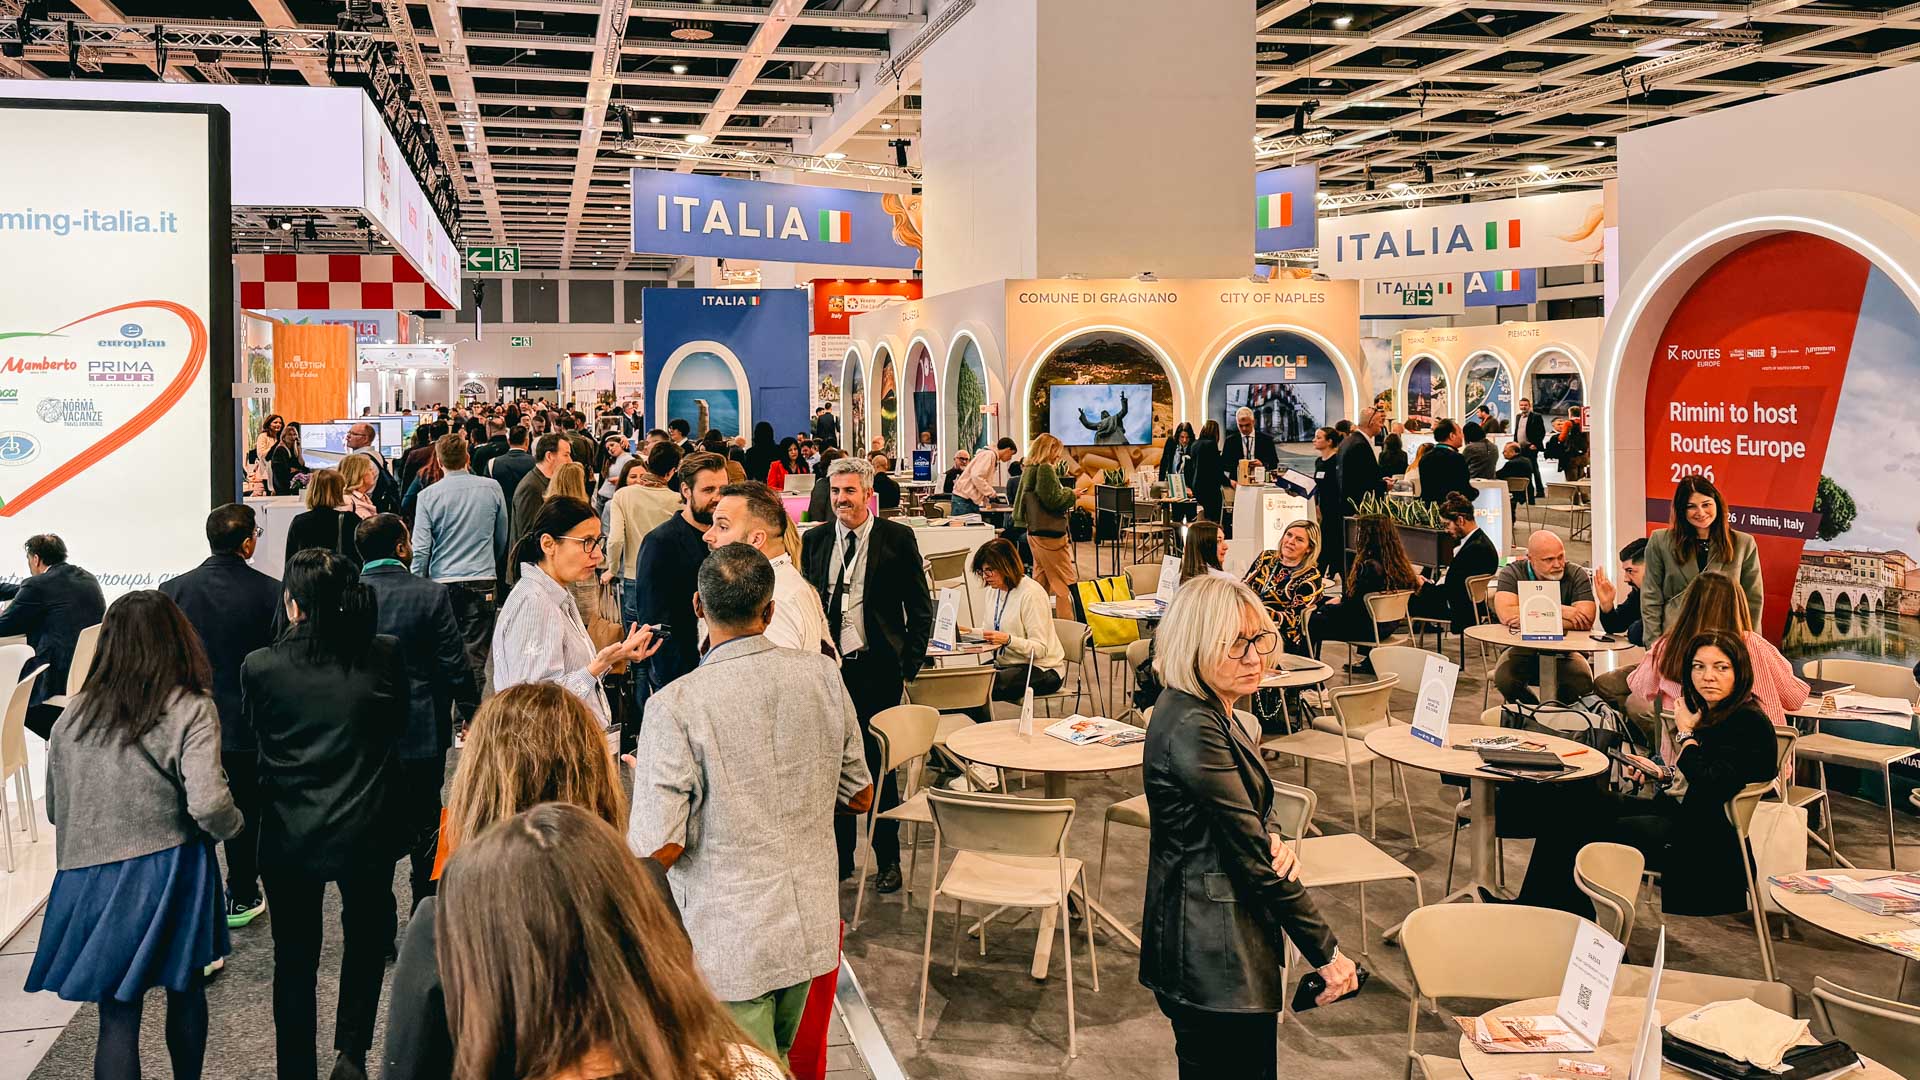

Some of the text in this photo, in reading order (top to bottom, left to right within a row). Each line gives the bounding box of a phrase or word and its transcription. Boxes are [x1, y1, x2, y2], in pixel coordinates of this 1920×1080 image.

[658, 195, 809, 241] ITALIA
[1337, 224, 1474, 262] ITALIA
[702, 295, 747, 306] ITALIA
[1019, 292, 1178, 304] COMUNE DI GRAGNANO
[1220, 292, 1325, 303] CITY OF NAPLES
[1508, 329, 1541, 338] PIEMONTE
[98, 338, 166, 349] europlan
[1681, 348, 1721, 360] ROUTES
[0, 356, 77, 374] Mamberto
[88, 361, 154, 372] PRIMA
[90, 373, 152, 381] TOUR
[62, 401, 94, 411] NORMA
[62, 411, 103, 421] VACANZE
[1669, 401, 1798, 424] Rimini to host
[1670, 432, 1806, 463] Routes Europe
[1750, 514, 1782, 530] Rimini,
[1783, 517, 1805, 532] Italy
